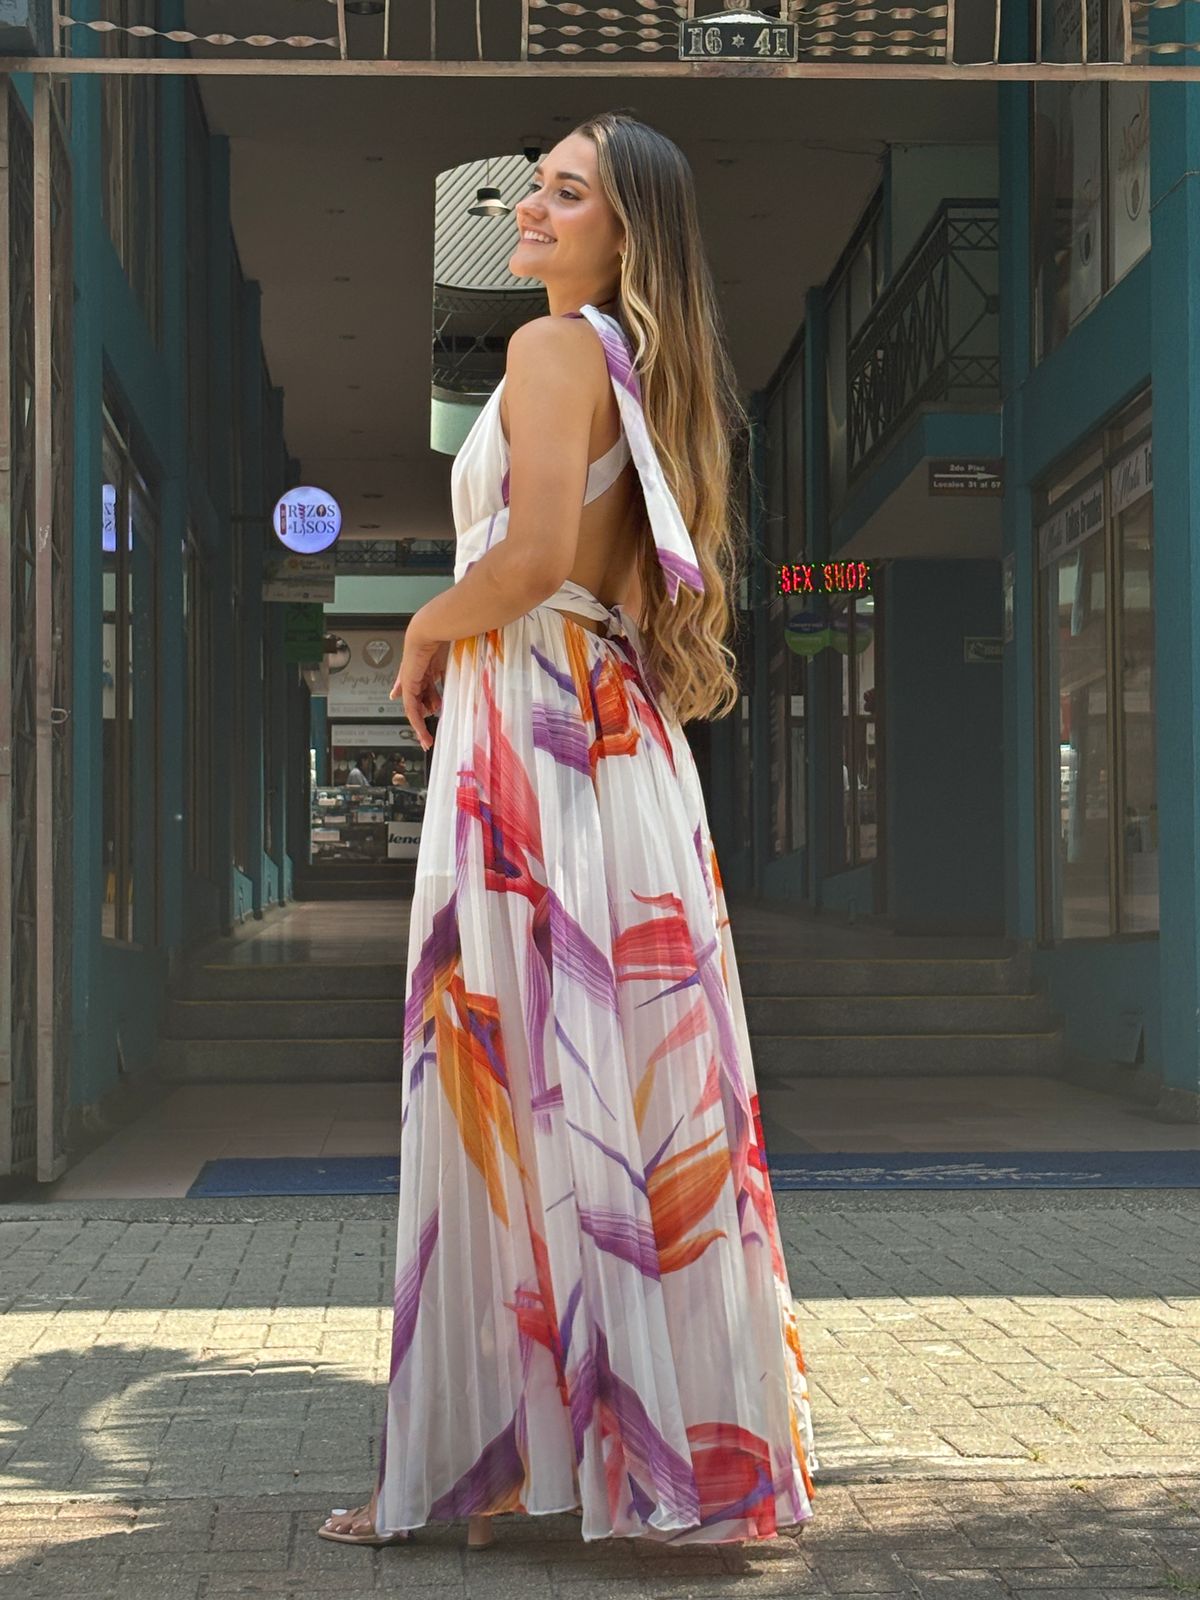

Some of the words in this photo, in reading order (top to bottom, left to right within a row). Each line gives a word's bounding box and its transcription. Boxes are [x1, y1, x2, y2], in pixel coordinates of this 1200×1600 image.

[688, 27, 722, 55] 16
[753, 27, 790, 56] 41
[782, 564, 814, 592] SEX
[823, 563, 866, 592] SHOP
